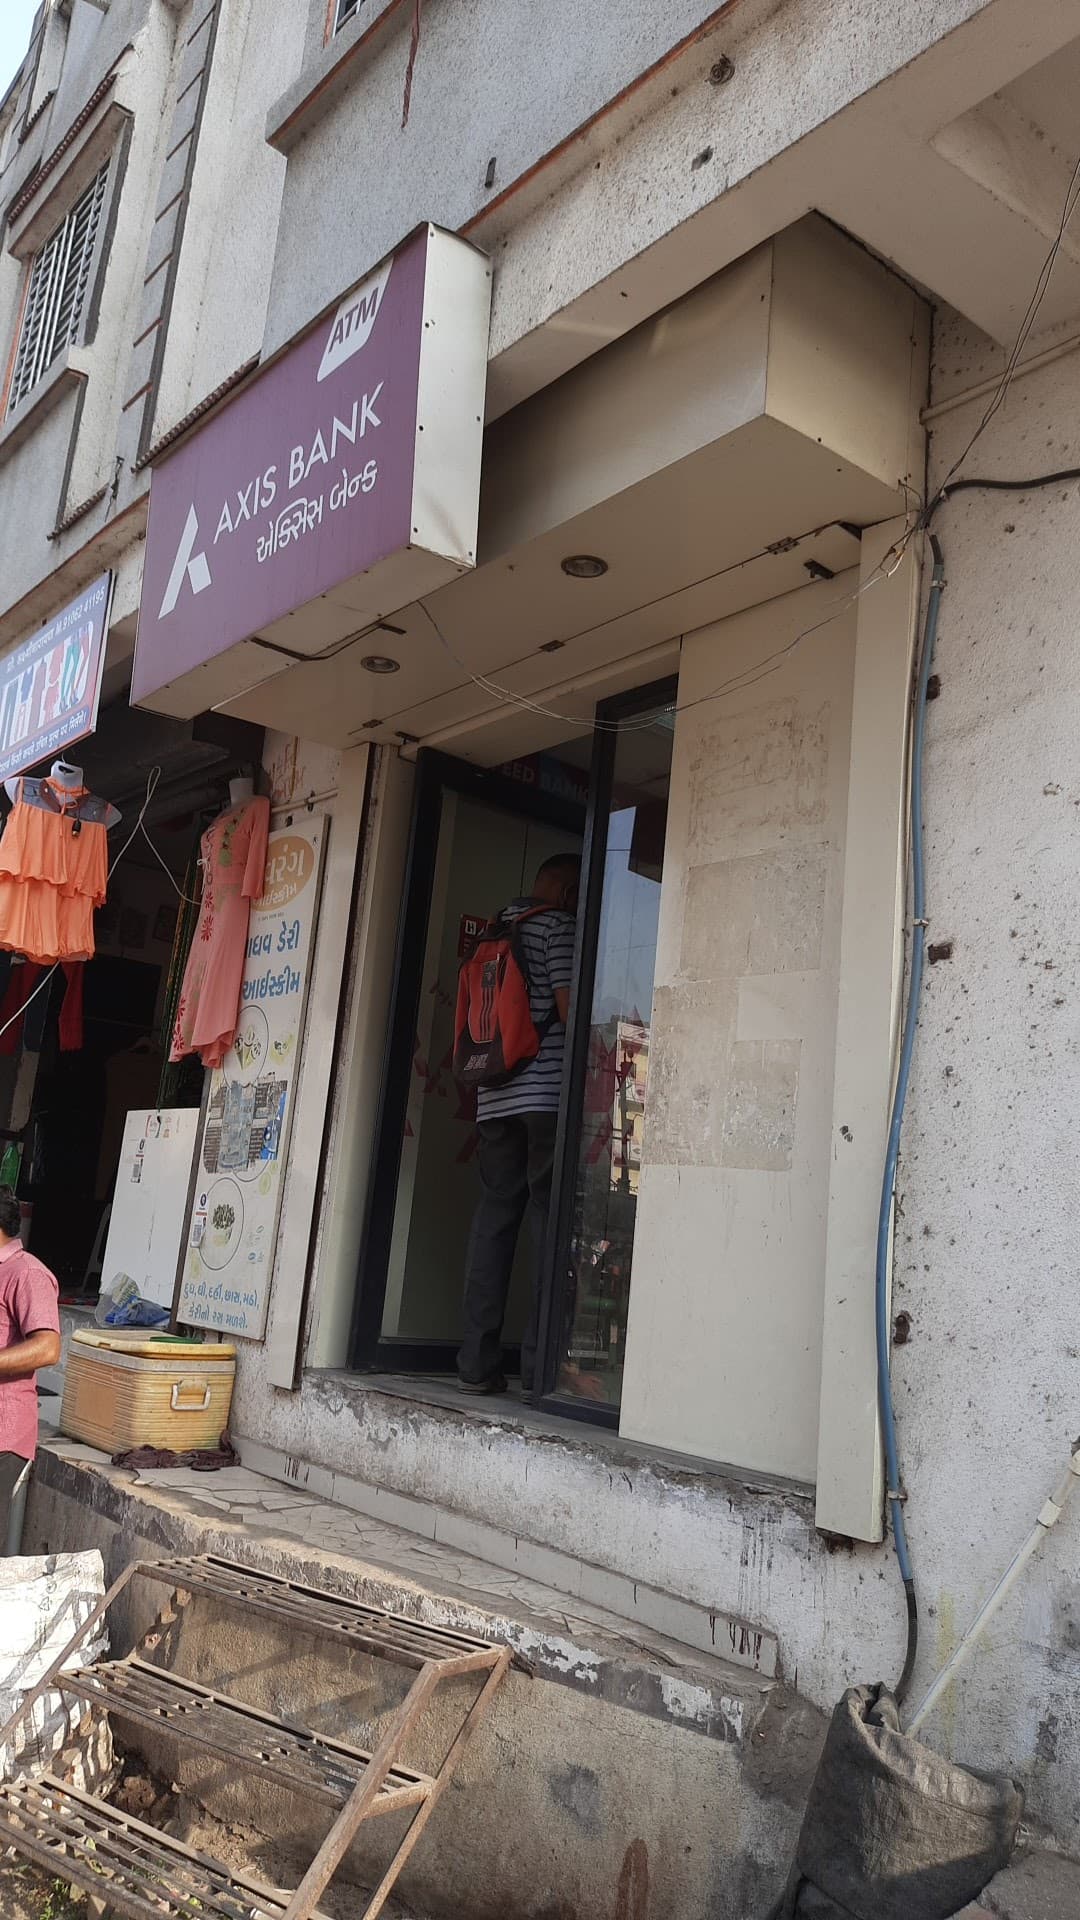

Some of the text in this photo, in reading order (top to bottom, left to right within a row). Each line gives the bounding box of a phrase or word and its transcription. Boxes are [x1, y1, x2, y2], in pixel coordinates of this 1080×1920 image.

[328, 287, 380, 353] ATM
[213, 381, 384, 544] AXIS BANK
[277, 919, 300, 952] ડેરી
